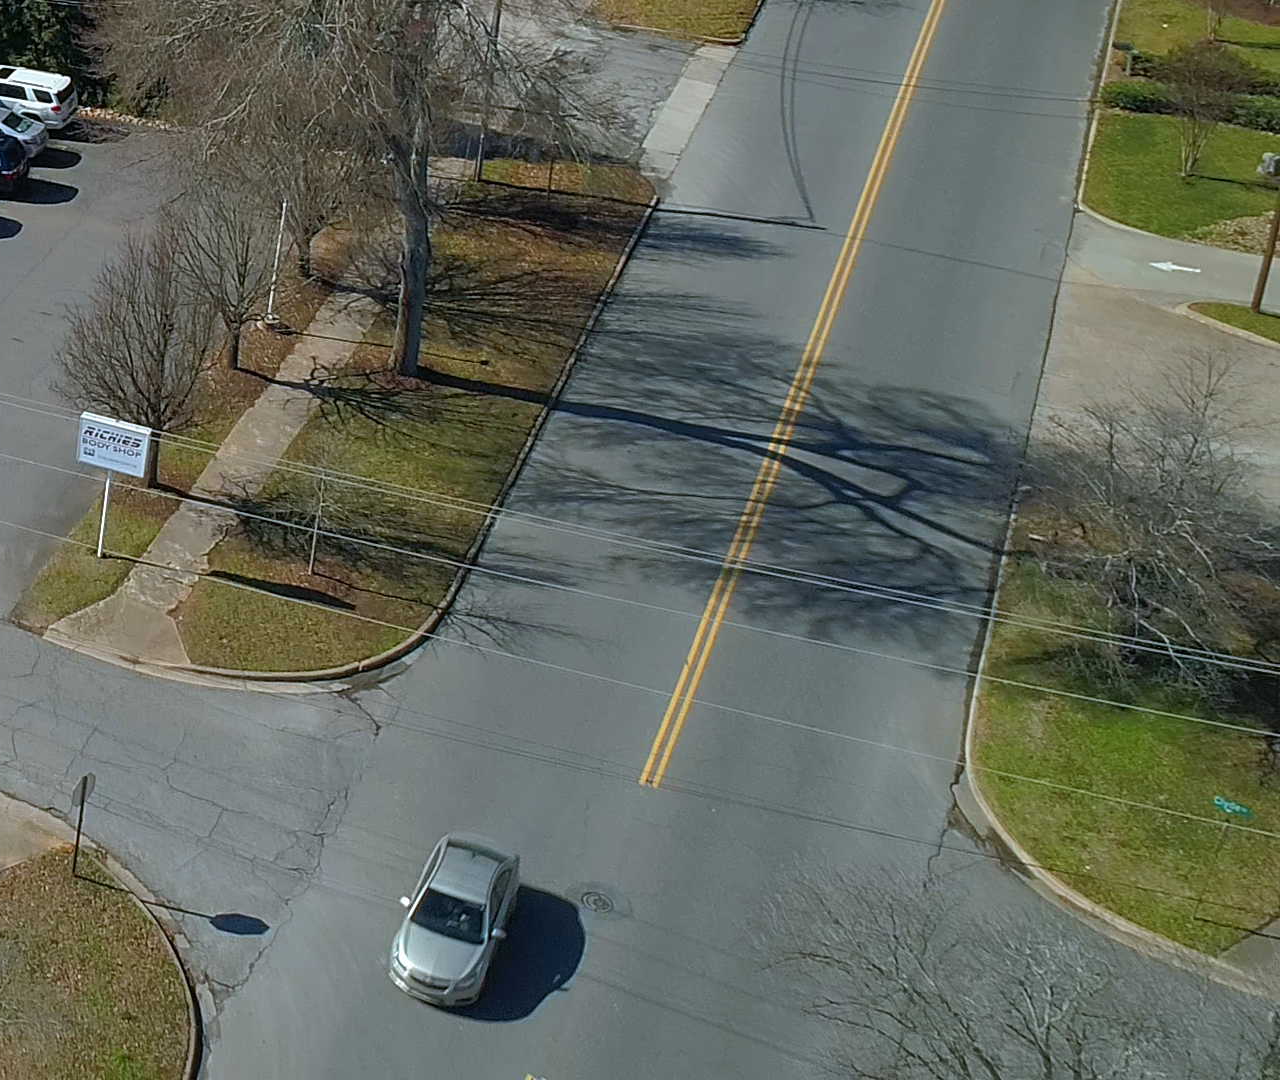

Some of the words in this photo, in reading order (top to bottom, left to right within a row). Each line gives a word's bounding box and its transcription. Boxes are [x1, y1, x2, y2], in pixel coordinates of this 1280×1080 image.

[83, 426, 142, 448] RICHIES
[82, 438, 111, 450] BODY
[113, 446, 142, 458] SHOP
